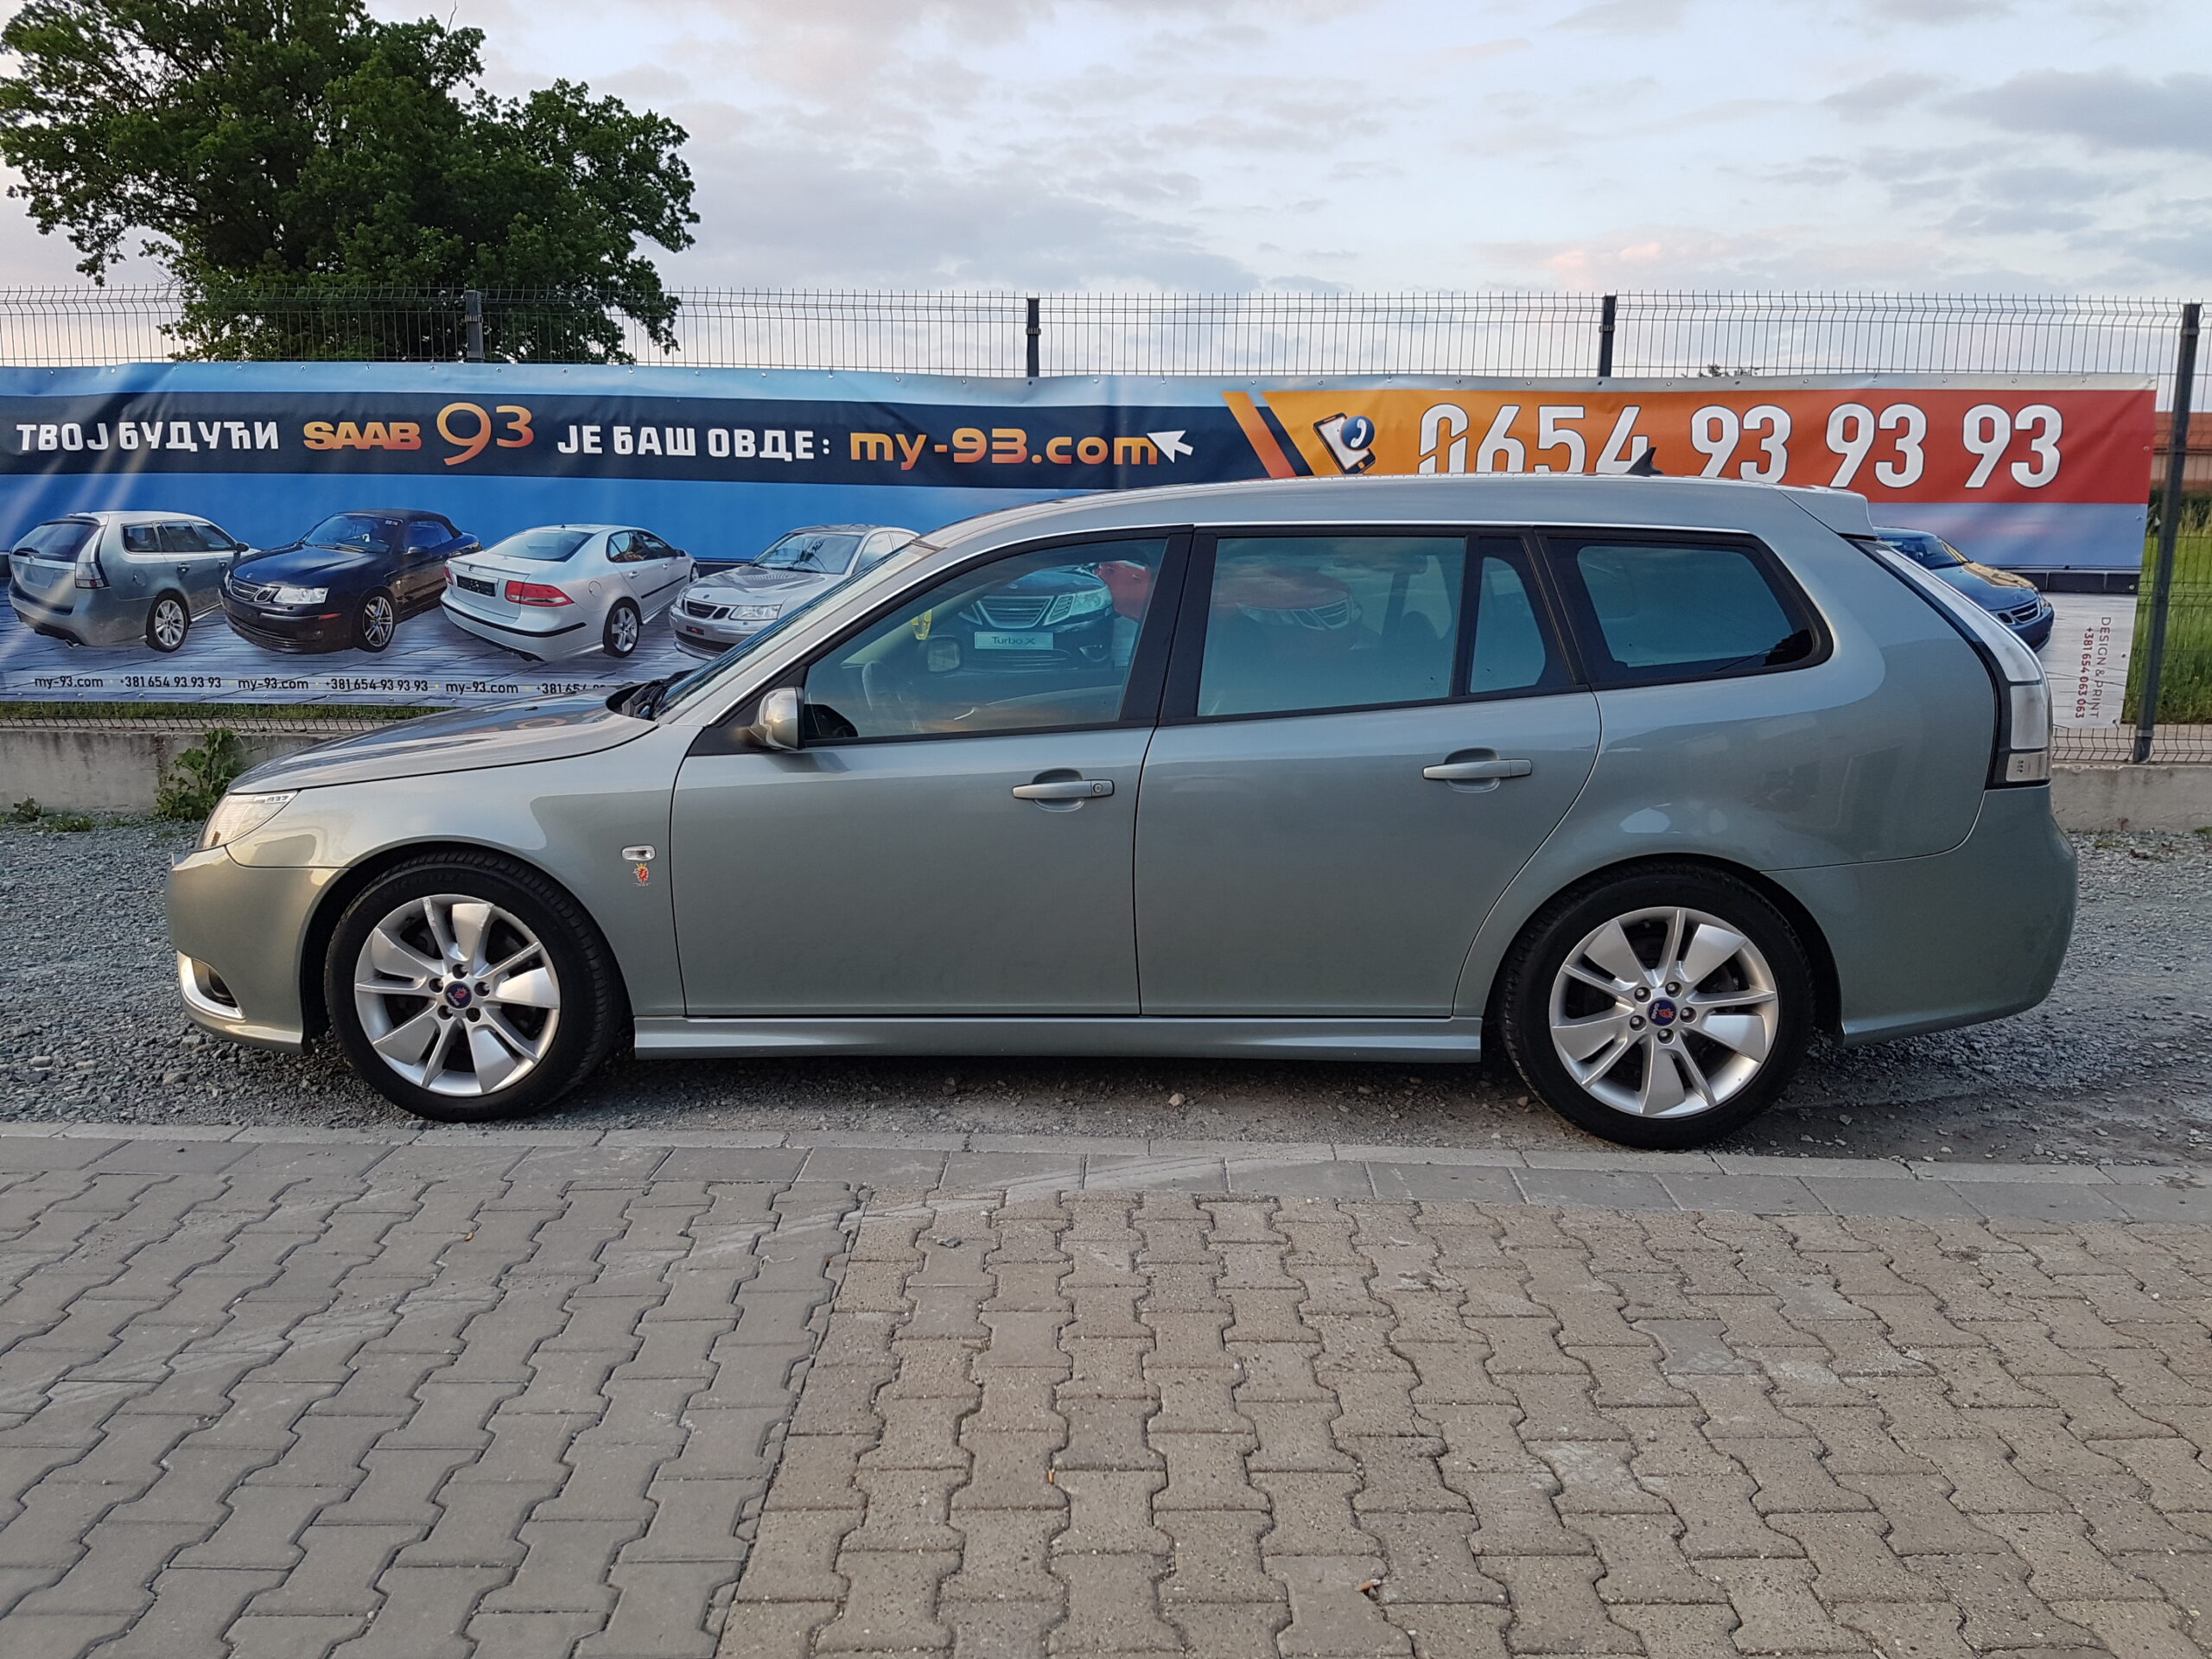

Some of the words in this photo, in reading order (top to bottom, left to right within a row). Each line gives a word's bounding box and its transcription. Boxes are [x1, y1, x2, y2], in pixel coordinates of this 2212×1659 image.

[16, 423, 109, 451] ТВОЈ
[118, 421, 279, 452] БУДУЋИ
[302, 421, 422, 450] SAAB
[436, 402, 534, 466] 93
[557, 424, 603, 454] ЈЕ
[613, 426, 696, 456] БАШ
[708, 428, 830, 461] ОВДЕ:
[850, 427, 1159, 470] my-93.com
[1417, 403, 1649, 474] 0654
[1690, 404, 1792, 484] 93
[1826, 402, 1928, 489] 93
[1962, 403, 2063, 489] 93
[991, 636, 1023, 645] Turbo
[2082, 627, 2094, 651] +381
[2096, 616, 2112, 665] DESIGN
[2080, 653, 2092, 673] 654
[34, 676, 104, 690] my-93.com
[174, 676, 188, 688] 93
[190, 677, 205, 688] 93
[207, 677, 222, 689] 93
[238, 677, 309, 692] my-93.com
[380, 679, 395, 691] 93
[397, 679, 411, 691] 93
[414, 680, 429, 692] 93
[445, 681, 519, 695] my-93.com
[2077, 676, 2089, 696] 063
[2075, 698, 2087, 719] 063
[2089, 680, 2104, 718] PRINT
